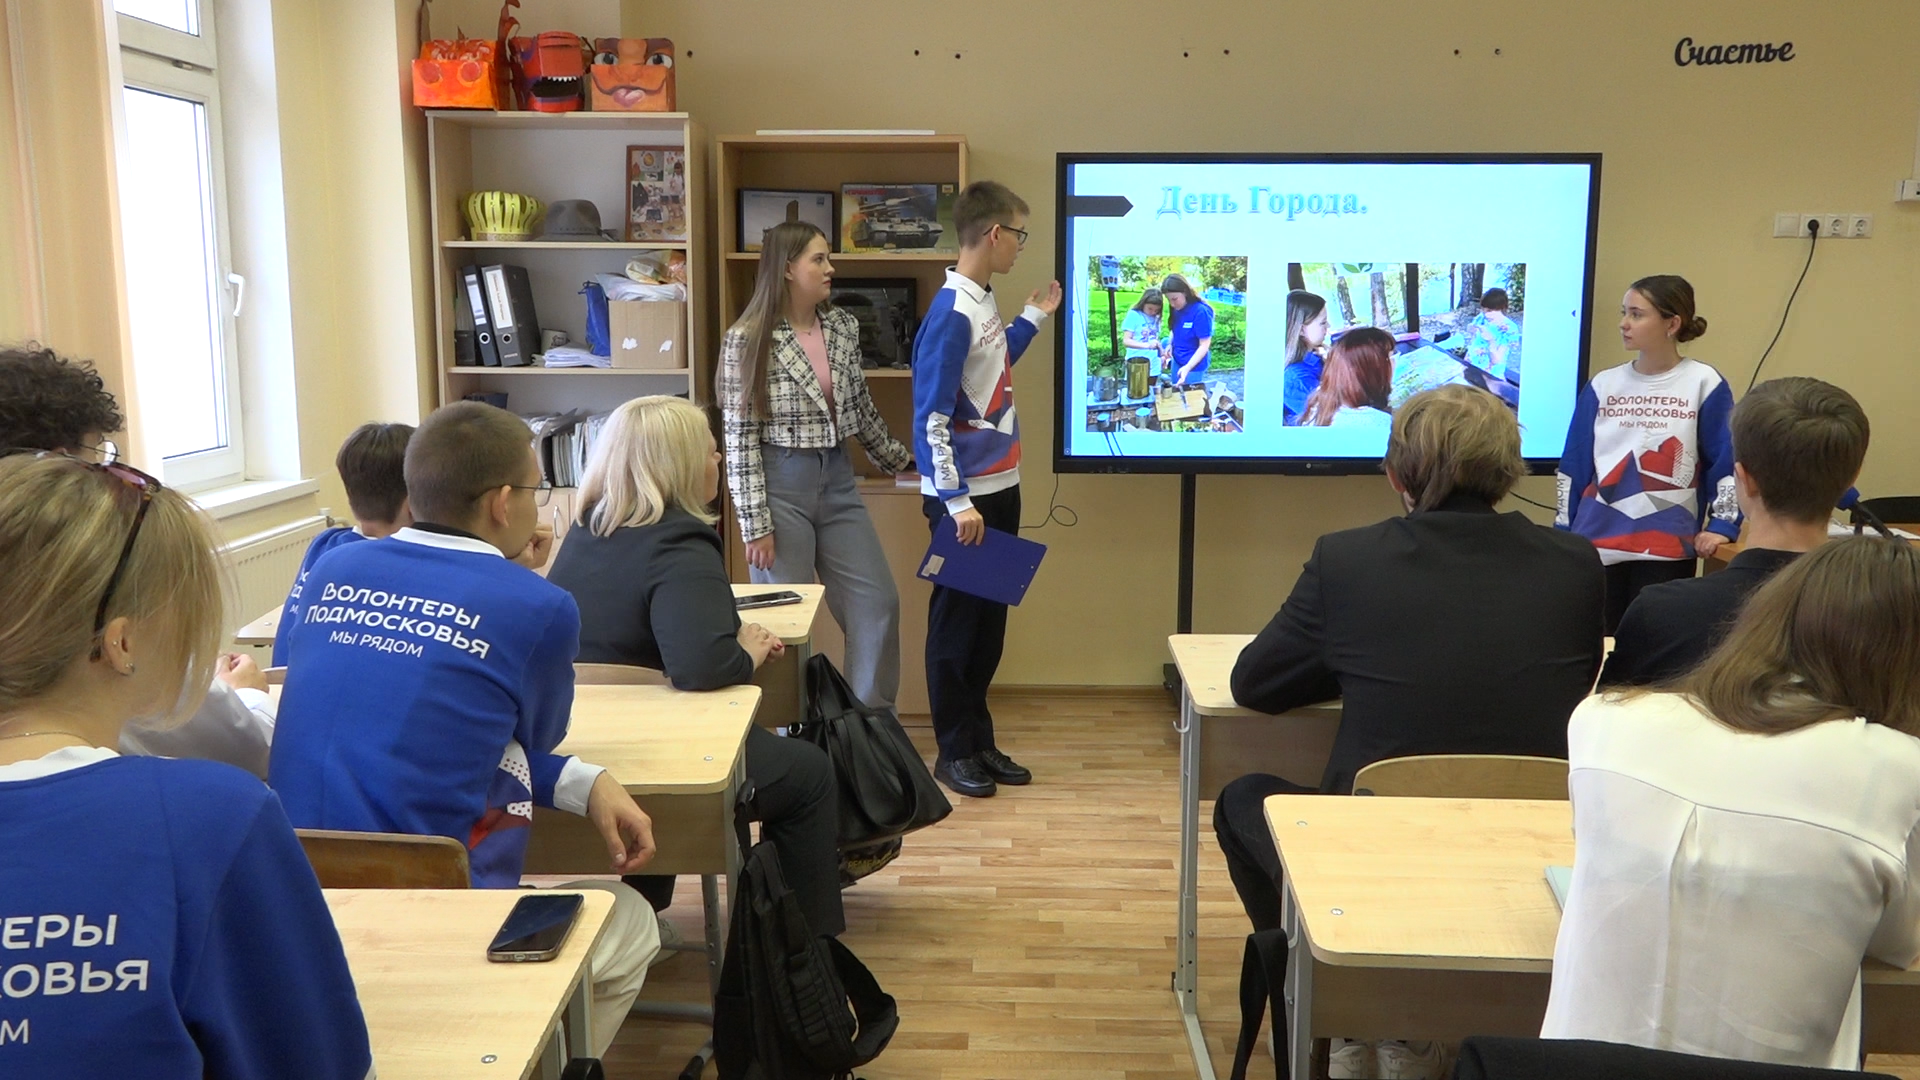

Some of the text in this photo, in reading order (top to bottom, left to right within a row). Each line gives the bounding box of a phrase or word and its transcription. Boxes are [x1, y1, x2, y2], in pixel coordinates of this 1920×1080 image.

[1674, 36, 1796, 67] Счастье
[1156, 185, 1368, 222] День Города.
[1597, 407, 1697, 420] ПОДМОСКОВЬЯ
[1606, 395, 1689, 407] ВОЛОНТЕРЫ
[1636, 421, 1668, 429] РЯДОМ
[320, 582, 482, 630] ВОЛОНТЕРЫ
[304, 604, 491, 660] ПОДМОСКОВЬЯ
[329, 630, 424, 659] МЫ РЯДОМ
[0, 914, 118, 949] ЕРЫ
[0, 959, 149, 998] ОВЬЯ
